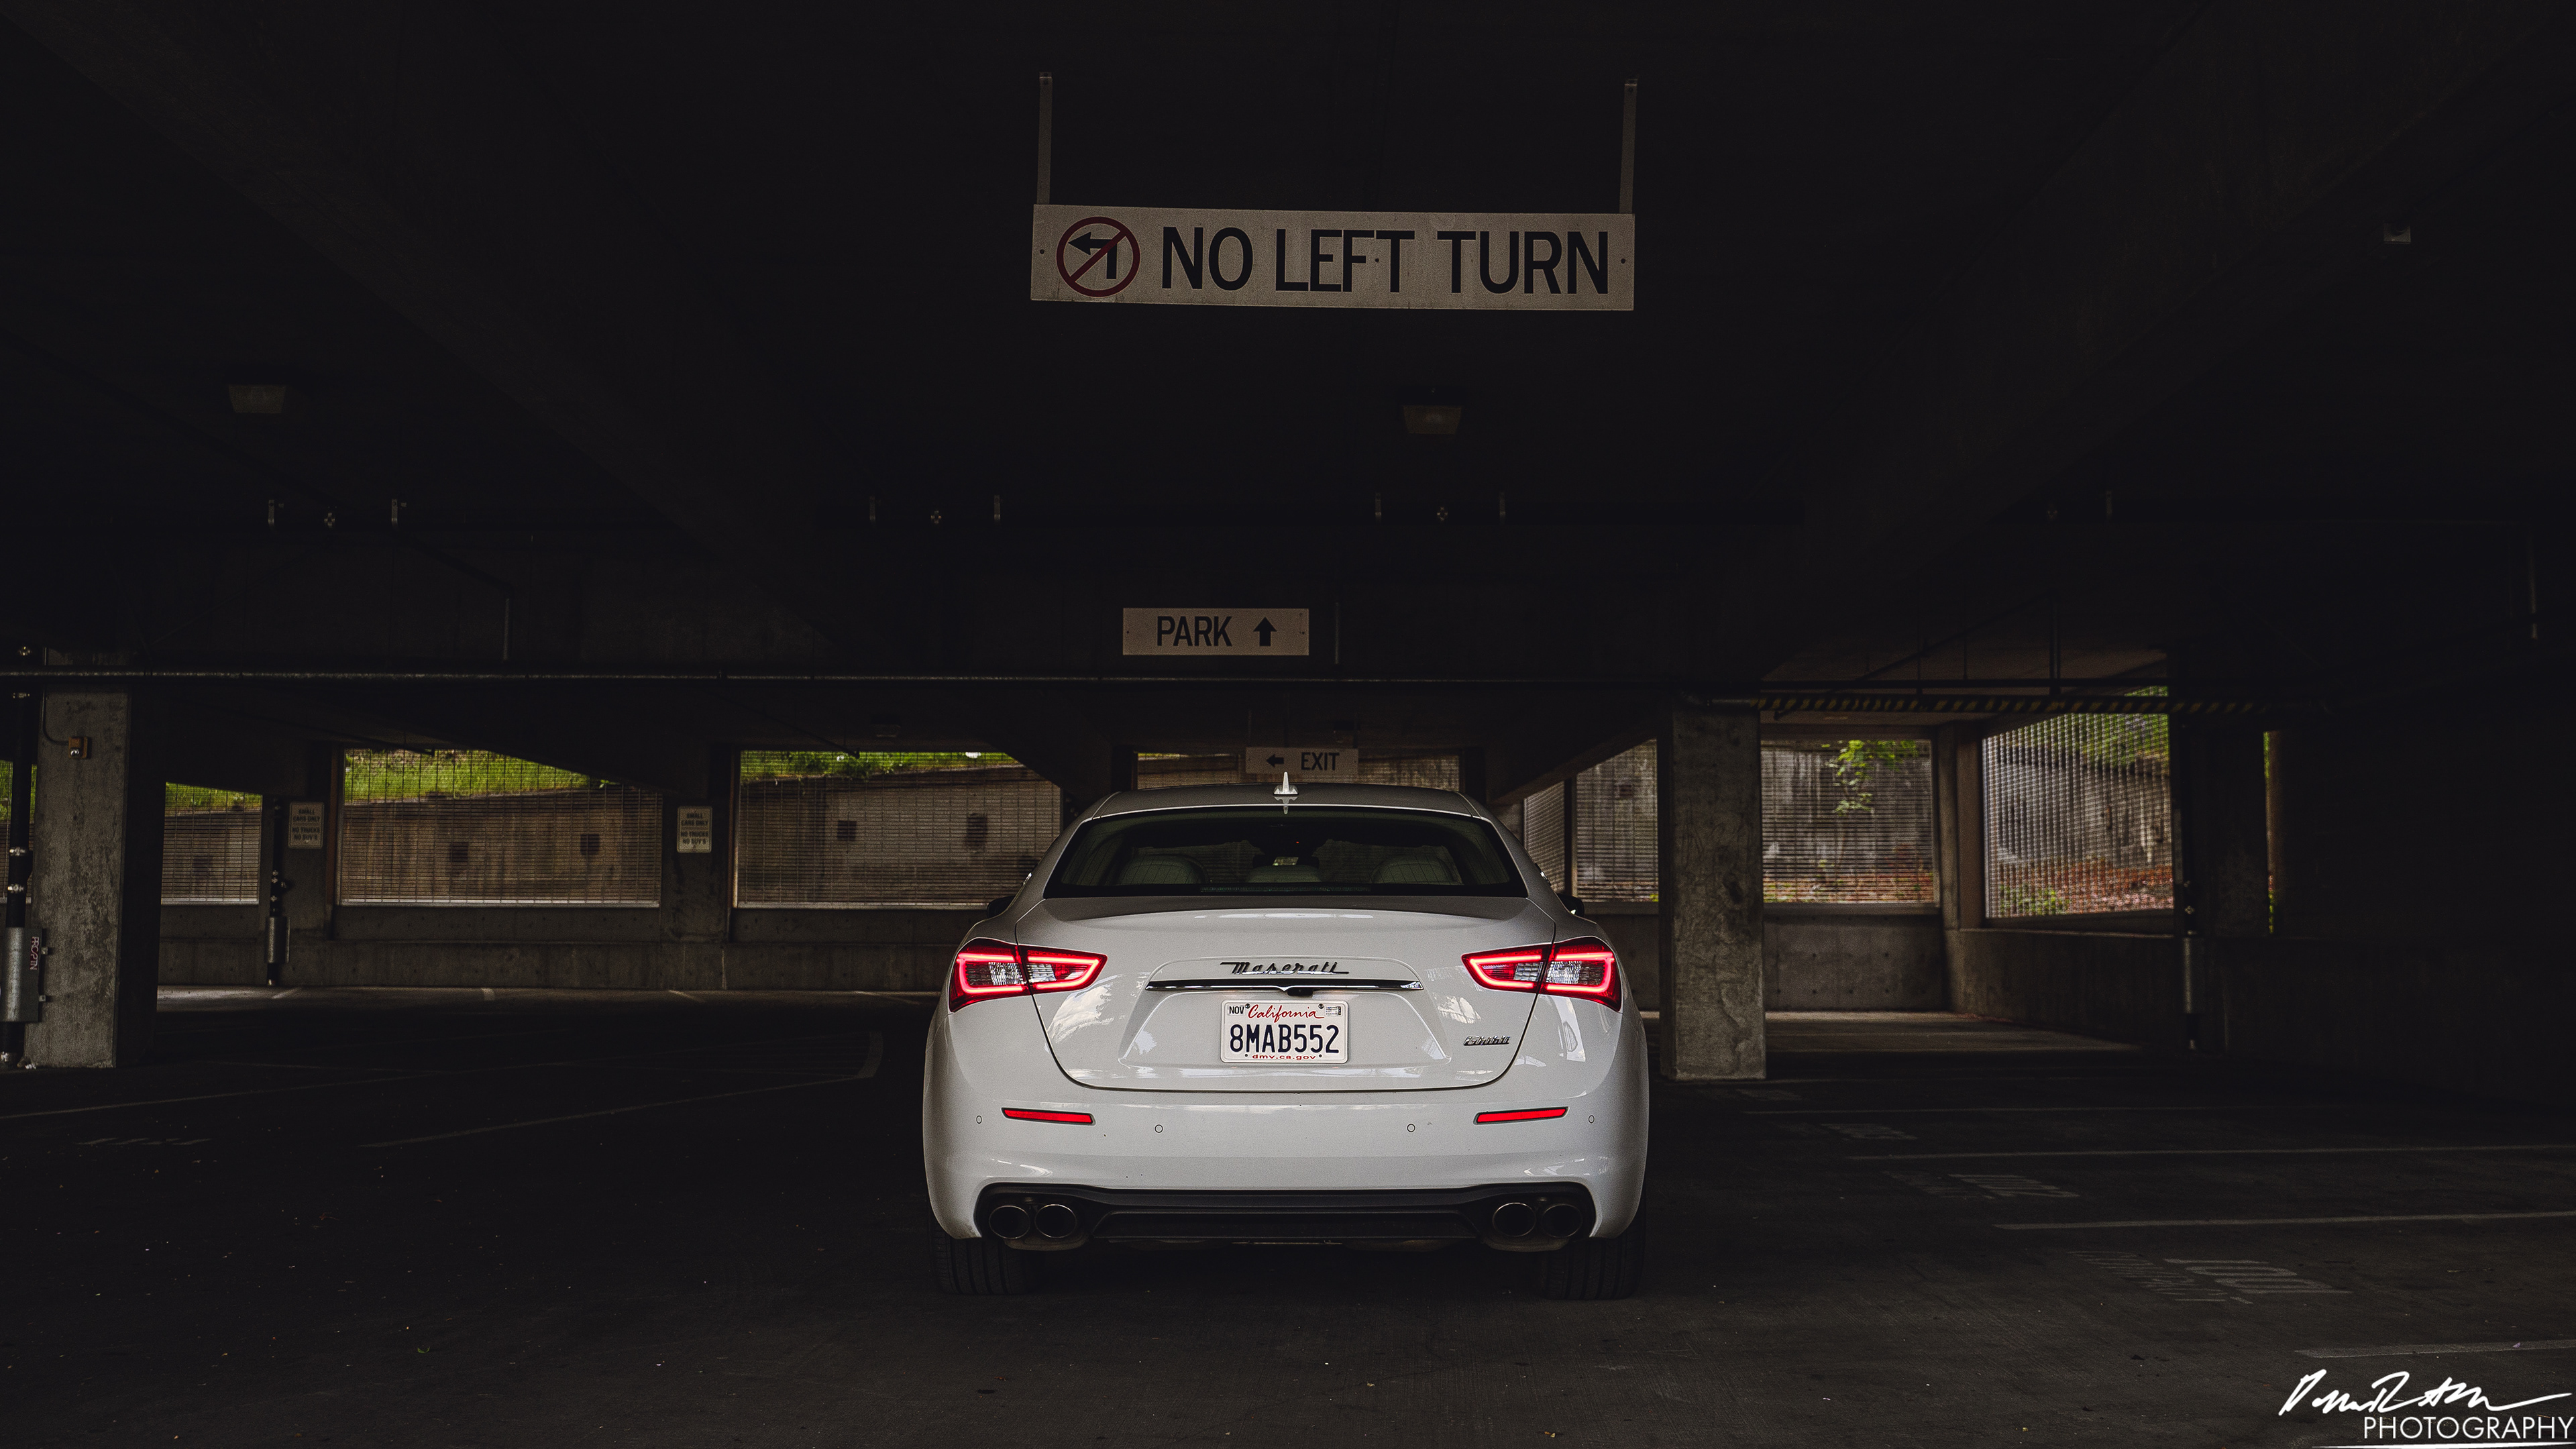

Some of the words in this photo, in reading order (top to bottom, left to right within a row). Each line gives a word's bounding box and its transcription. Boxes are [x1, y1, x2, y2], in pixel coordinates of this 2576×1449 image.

[1161, 226, 1253, 290] NO
[1275, 229, 1414, 292] LEFT
[1437, 231, 1609, 294] TURN
[1157, 616, 1232, 647] PARK
[1301, 752, 1340, 771] EXIT
[1220, 961, 1349, 975] Maserati
[1229, 1006, 1244, 1015] NOV
[1248, 1004, 1324, 1023] California
[1230, 1024, 1340, 1054] 8MAB552
